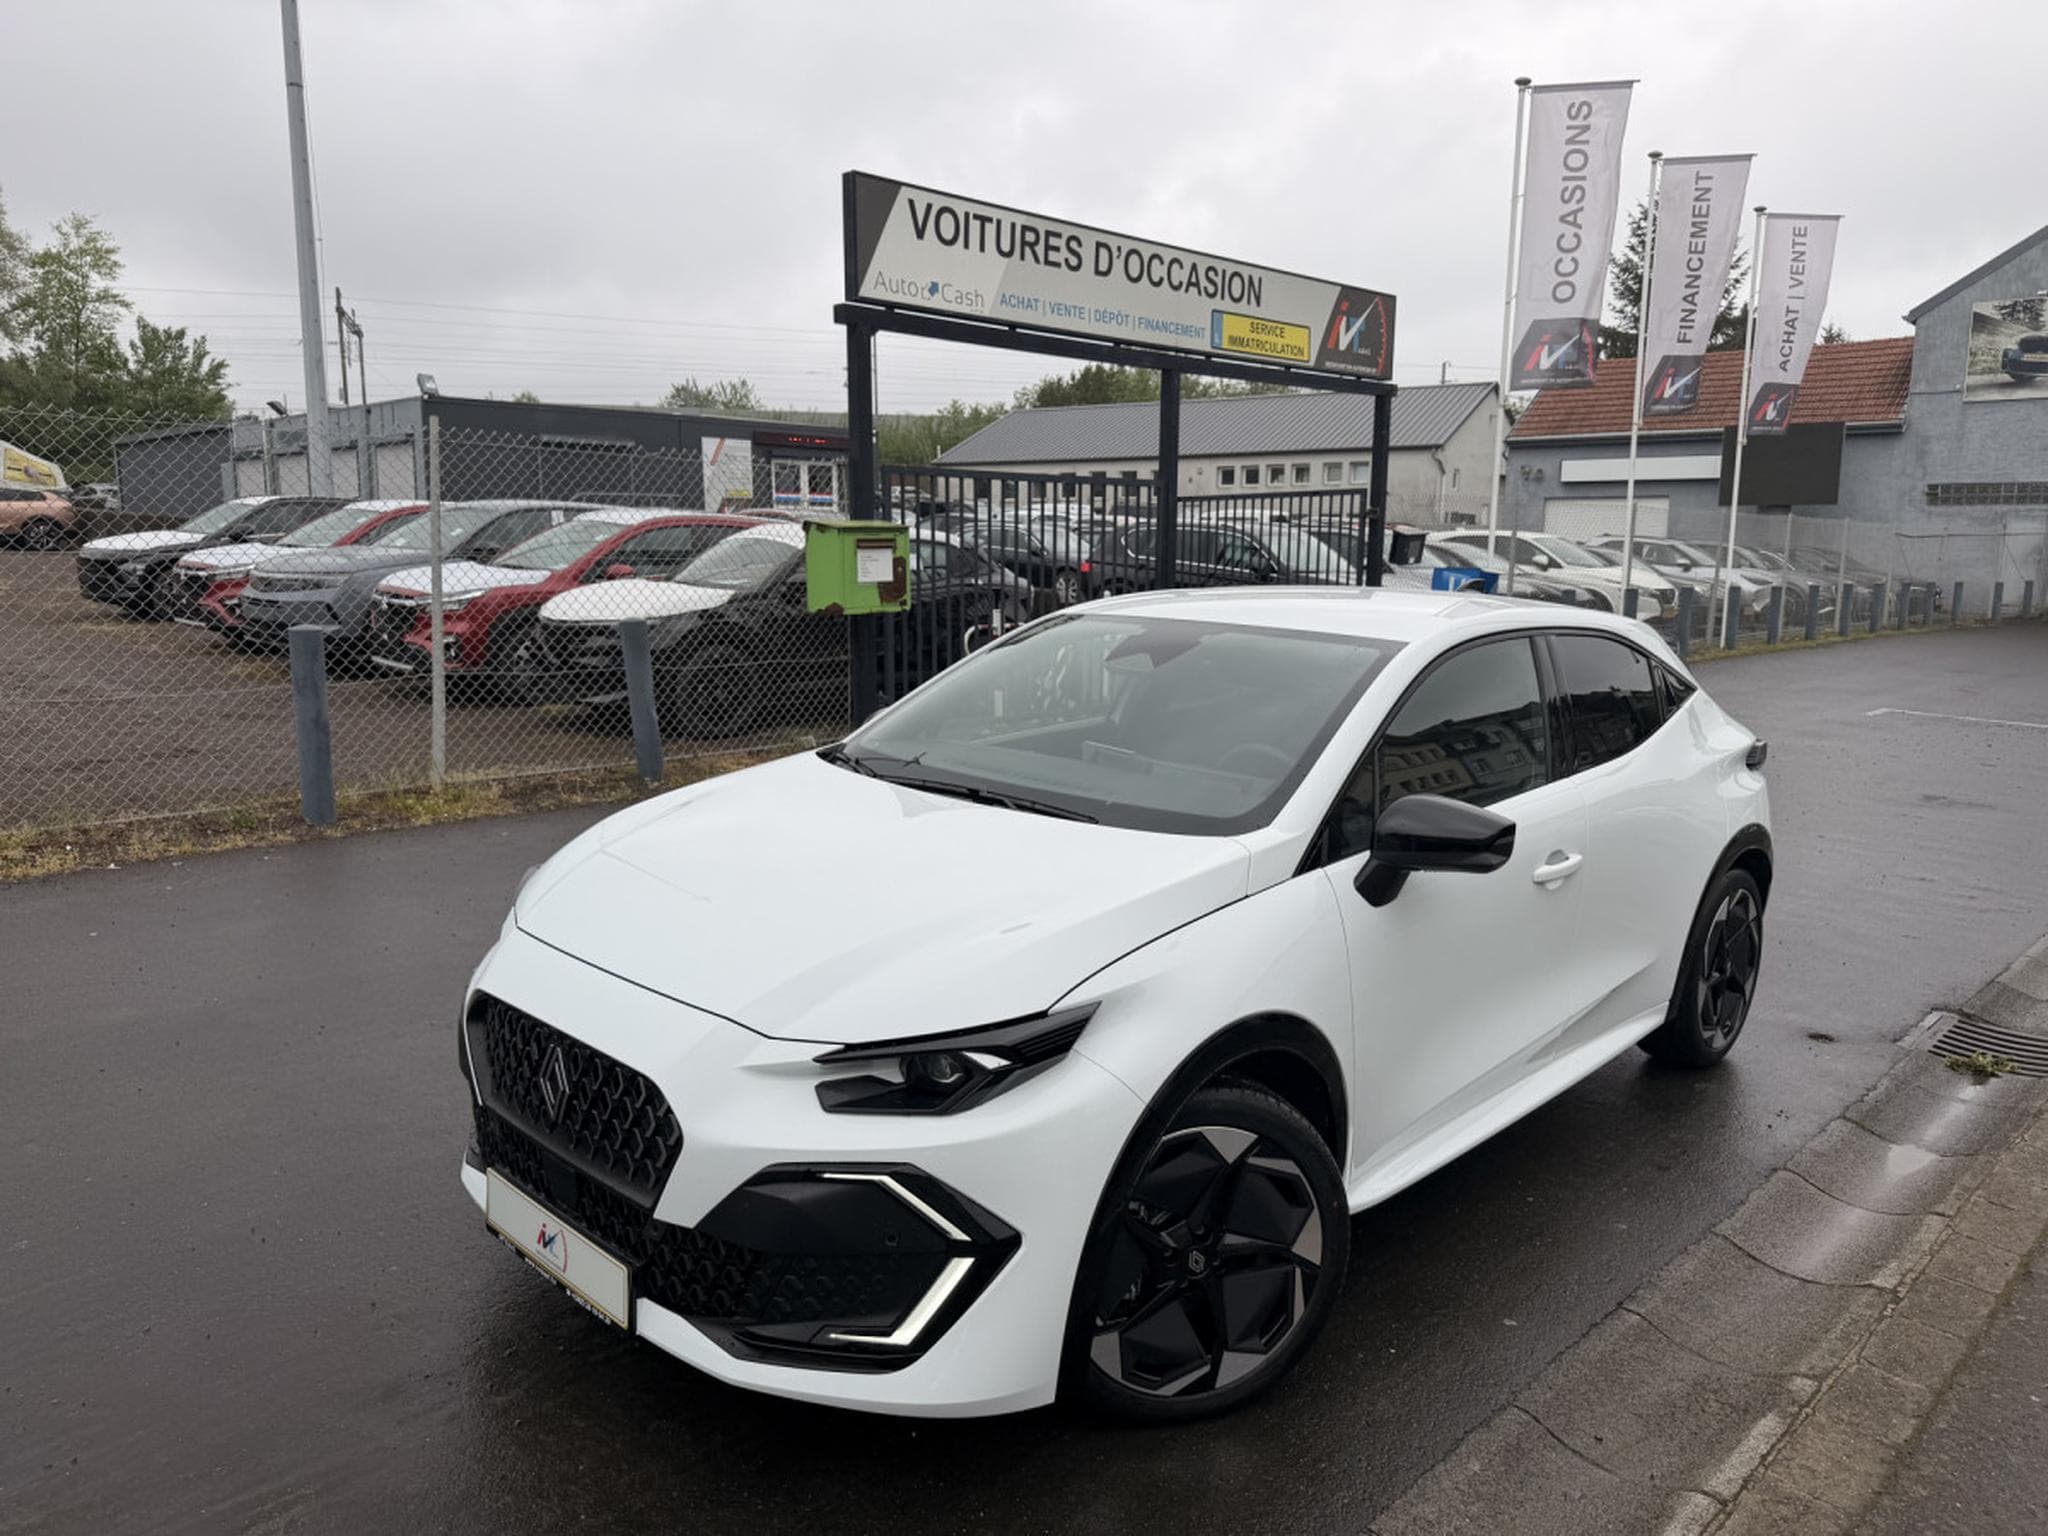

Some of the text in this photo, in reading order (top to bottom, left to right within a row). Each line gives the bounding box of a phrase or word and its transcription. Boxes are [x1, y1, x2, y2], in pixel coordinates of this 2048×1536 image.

[907, 198, 1263, 307] VOITURES D'OCCASION
[1551, 99, 1593, 305] OCCASIONS
[1676, 170, 1714, 344] FINANCEMENT
[1778, 226, 1808, 372] ACHAT VENTE
[999, 293, 1206, 339] ACHAT VENTE DÉPÔT FINANCEMENT
[1228, 334, 1305, 358] IMMATRICULATION
[1249, 321, 1286, 339] SERVICE
